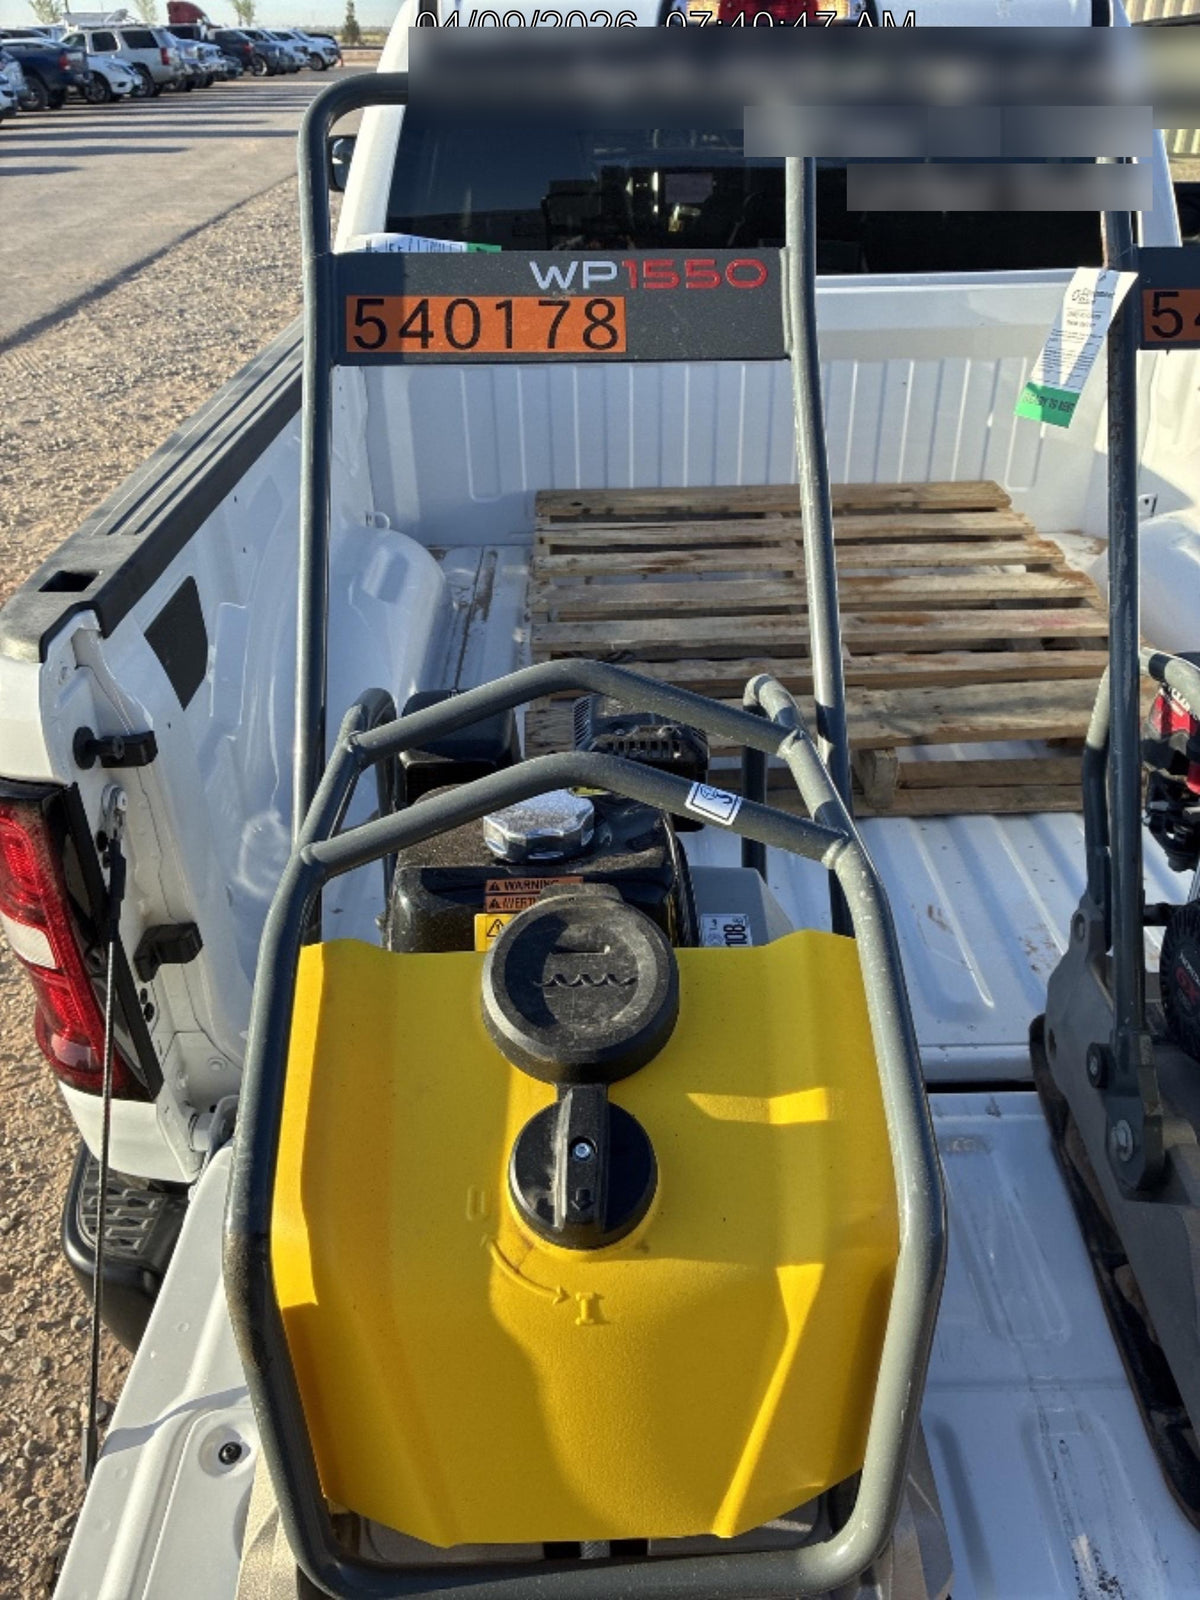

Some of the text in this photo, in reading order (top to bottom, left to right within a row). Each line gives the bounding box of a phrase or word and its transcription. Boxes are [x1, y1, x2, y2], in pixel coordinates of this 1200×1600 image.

[529, 259, 769, 289] WP1550
[353, 298, 619, 350] 540178
[1151, 291, 1200, 338] 5
[723, 923, 748, 948] 108
